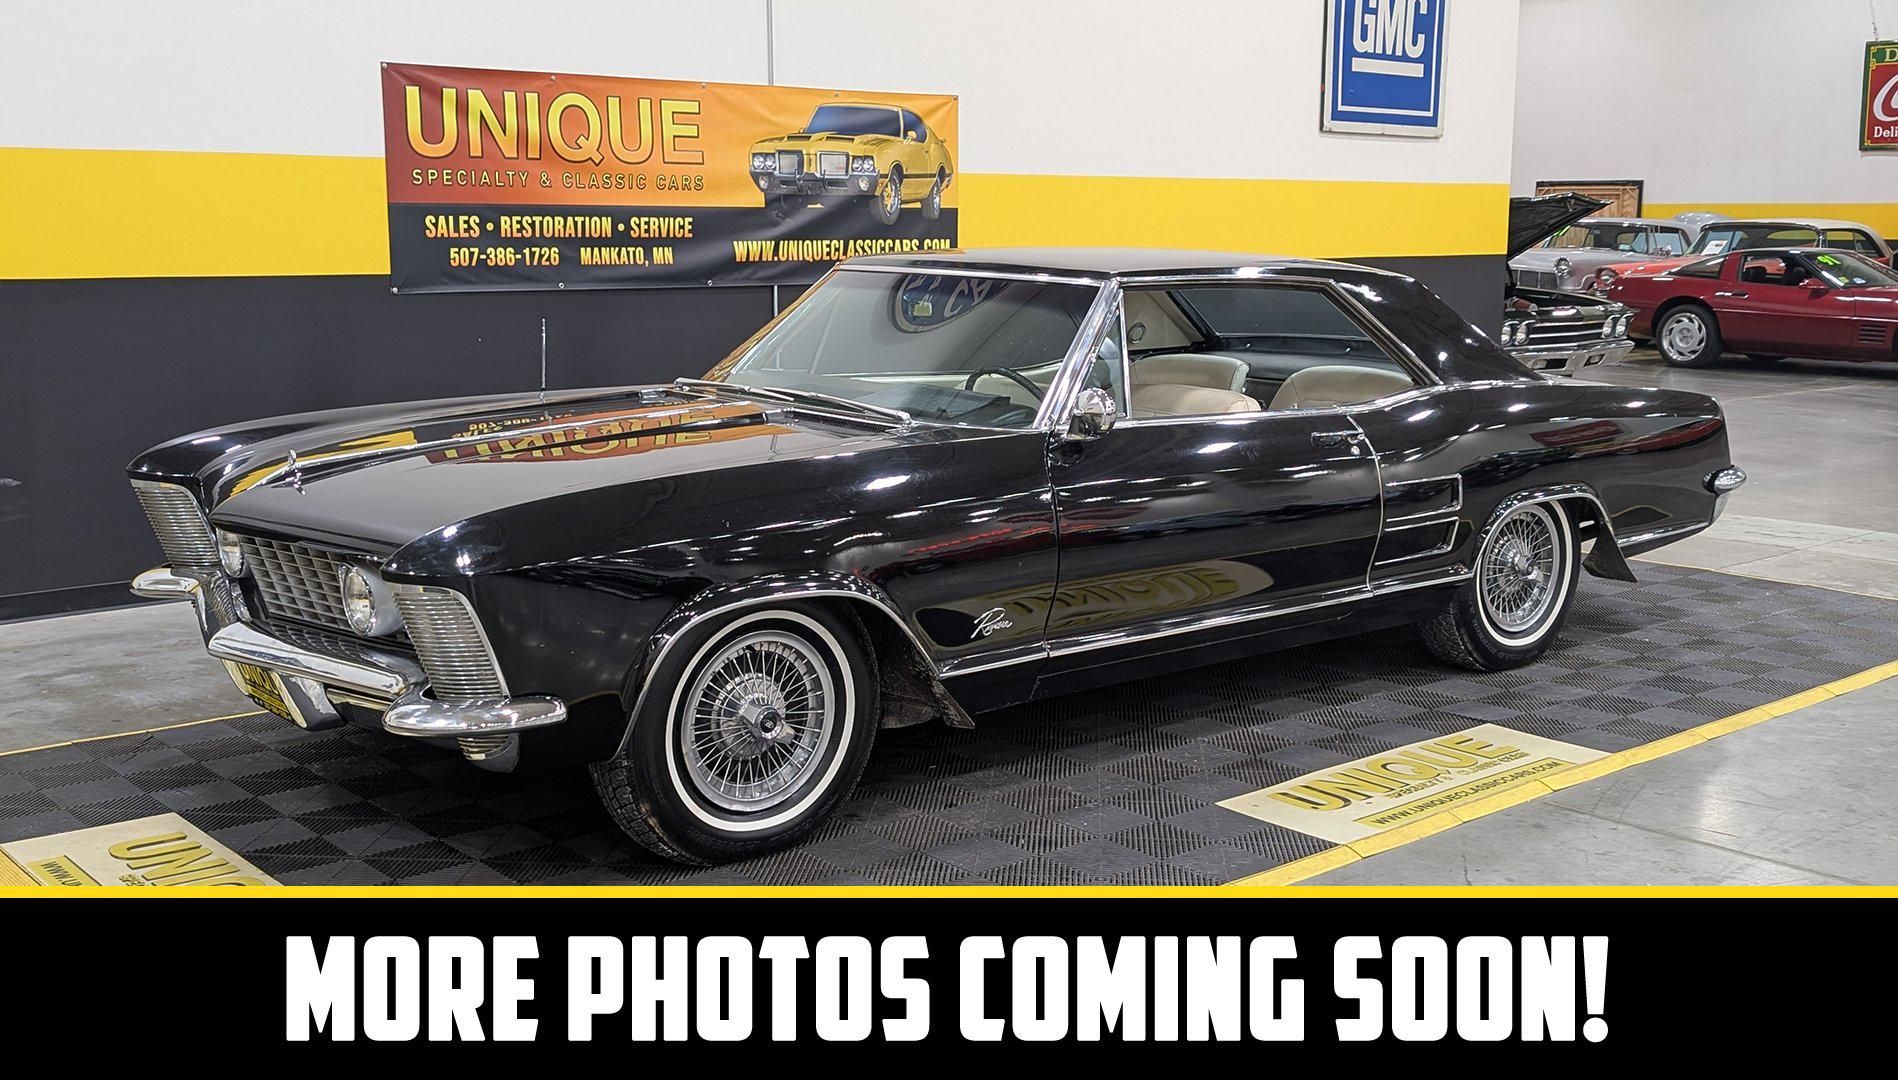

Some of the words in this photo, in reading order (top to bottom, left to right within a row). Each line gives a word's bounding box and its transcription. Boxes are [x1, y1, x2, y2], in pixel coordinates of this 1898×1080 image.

[1352, 0, 1428, 58] GMC
[404, 85, 705, 167] UNIQUE
[1873, 126, 1898, 138] Deli
[411, 168, 529, 188] SPECIALTY
[540, 172, 552, 188] &
[562, 172, 648, 190] CLASSIC
[656, 174, 705, 191] CARS
[424, 214, 480, 239] SALES
[500, 215, 612, 238] RESTORATION
[629, 216, 693, 239] SERVICE
[449, 246, 560, 267] 507-386-1726
[579, 246, 649, 267] MANKATO,
[652, 246, 674, 265] MN
[1266, 735, 1521, 812] UNIQUE
[107, 831, 265, 886] UNI
